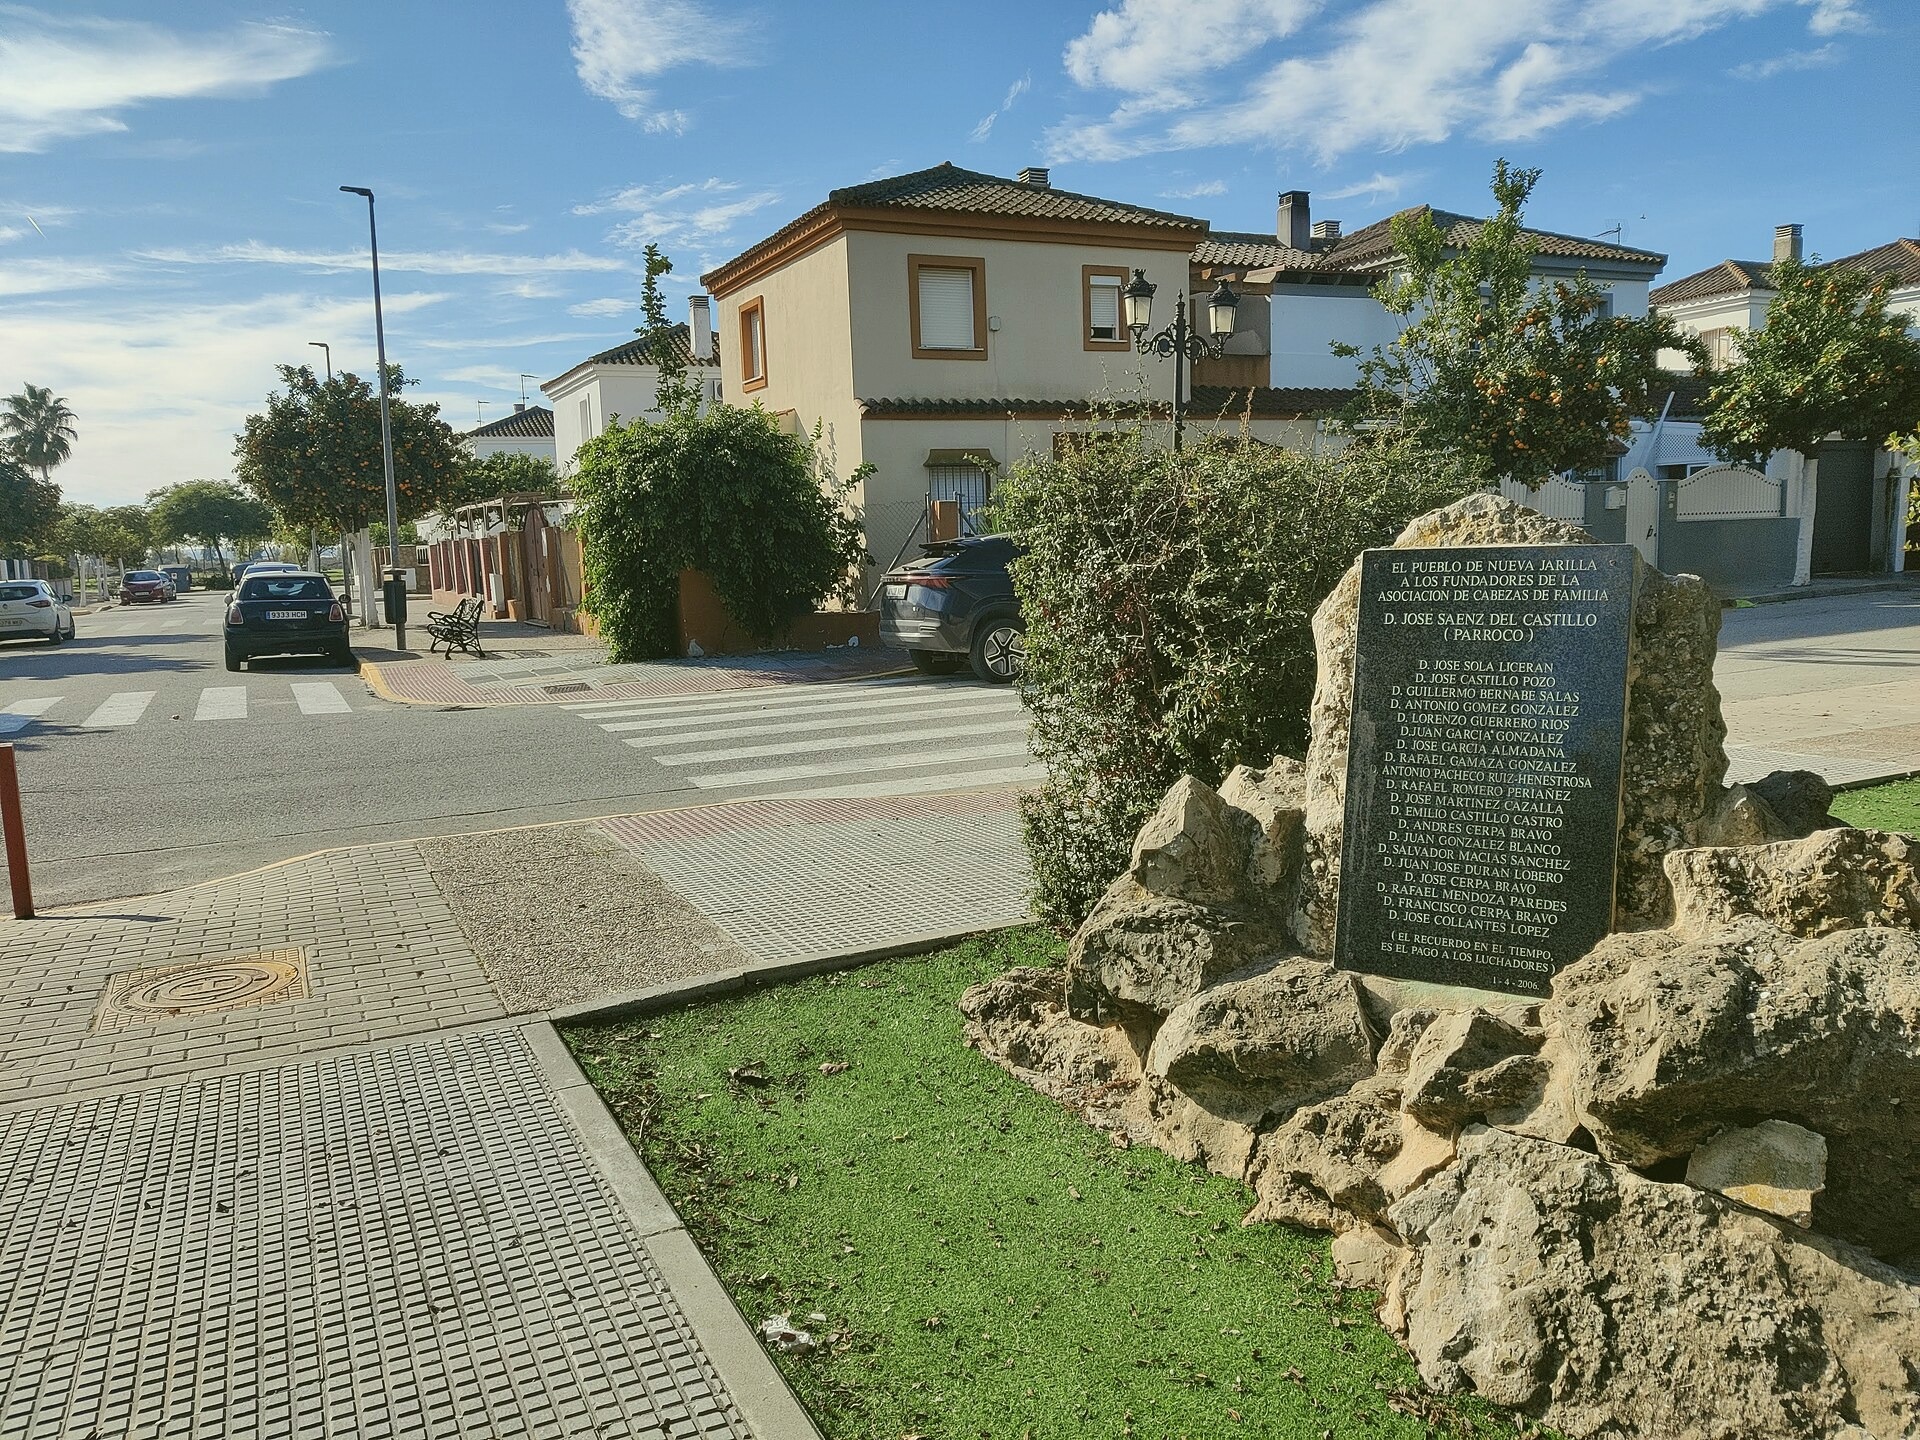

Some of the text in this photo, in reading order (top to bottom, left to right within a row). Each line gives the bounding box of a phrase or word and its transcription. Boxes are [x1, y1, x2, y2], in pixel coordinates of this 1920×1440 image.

[1391, 560, 1597, 573] EL PUEBLO DE NUEVA JARILLA
[1400, 575, 1579, 587] A LOS FUNDADORES DE LA
[1377, 590, 1608, 602] ASOCIACION DE CABEZAS DE FAMILIA
[1383, 614, 1597, 626] D. JOSE SAENZ DEL CASTILLO
[1418, 660, 1553, 673] D. JOSE SOLA LICERAN
[1415, 673, 1555, 687] D. JOSE CASTILLO POZO
[1391, 686, 1579, 702] D. GUILLERMO BERNABE SALAS
[1390, 699, 1578, 716] D. ANTONIO GOMEZ GONZALEZ
[1396, 713, 1572, 730] D. LORENZO GUERRERO RIOS
[1446, 728, 1491, 741] GARCIA
[1496, 731, 1564, 744] GONZALEZ
[1396, 740, 1564, 758] D. JOSE GARCIA ALMADANA
[1384, 752, 1576, 771] D. RAFAEL GAMAZA GONZALEZ
[1381, 765, 1430, 778] ANTONIO
[1433, 768, 1484, 781] PACHECO
[1488, 772, 1592, 788] RUIZ-HENESTROSA
[1386, 780, 1570, 801] D. RAFAEL ROMERO PERIAÑEZ
[1390, 793, 1563, 814] D. JOSE MARTINEZ CAZALLA
[1390, 806, 1562, 828] D. EMILIO CASTILLO CASTRO
[1398, 819, 1552, 841] D. ANDRES CERPA BRAVO
[1388, 831, 1561, 855] D. JUAN GONZALEZ BLANCO
[1377, 843, 1570, 870] D. SALVADOR MACIAS SANCHEZ
[1383, 857, 1563, 883] D. JUAN JOSE DURAN LOBERO
[1404, 872, 1536, 894] D. JOSE CERPA BRAVO
[1377, 882, 1566, 911] D. RAFAEL MENDOZA PAREDES
[1383, 896, 1558, 925] D. FRANCISCO CERPA BRAVO
[1388, 910, 1549, 937] D. JOSE COLLANTES LOPEZ
[1380, 942, 1392, 953] ES
[1395, 944, 1408, 955] EL
[1411, 946, 1438, 959] PAGO
[1441, 950, 1449, 960] A
[1452, 951, 1472, 964] LOS
[1413, 933, 1470, 951] RECUERDO
[1474, 940, 1488, 953] EN
[1491, 943, 1504, 955] EL
[1508, 945, 1554, 962] TIEMPO,
